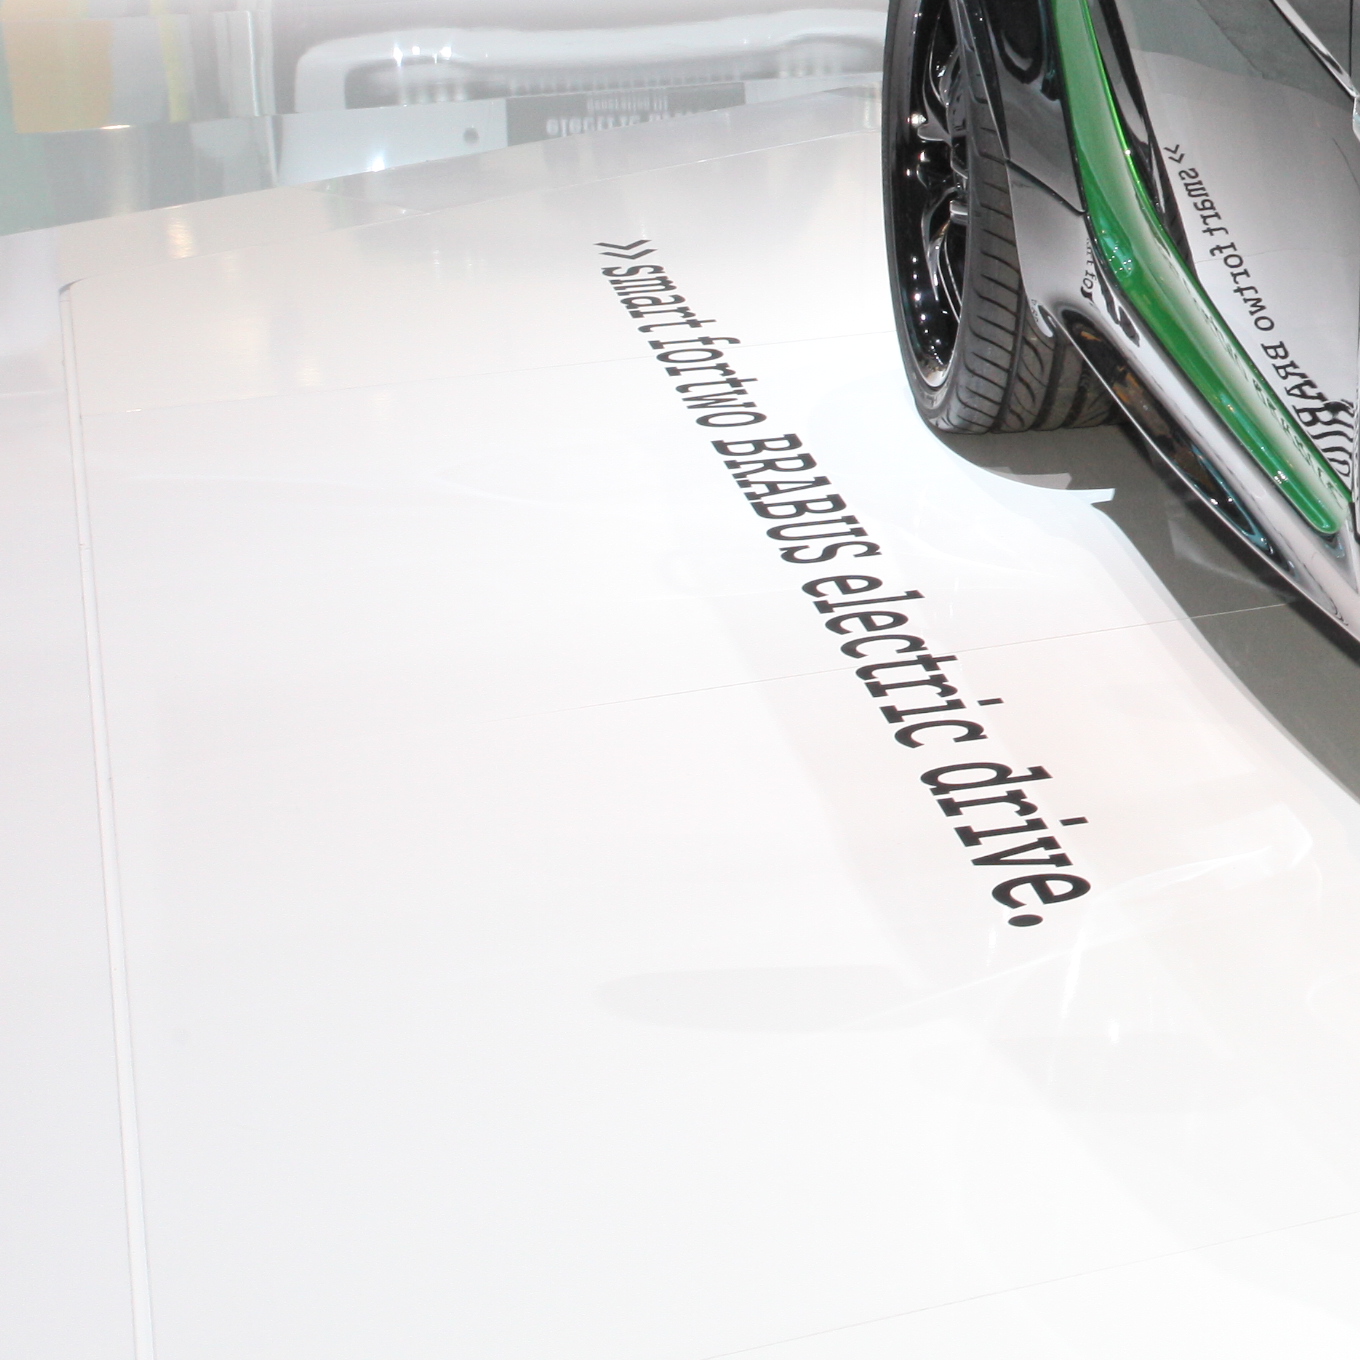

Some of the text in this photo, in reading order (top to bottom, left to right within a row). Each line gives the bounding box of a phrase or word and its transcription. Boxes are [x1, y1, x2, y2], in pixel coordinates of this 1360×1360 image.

[601, 264, 716, 333] smart
[648, 336, 767, 427] fortwo
[711, 434, 882, 564] BRABUS
[801, 573, 1004, 748] electric
[920, 761, 1091, 928] drive.
